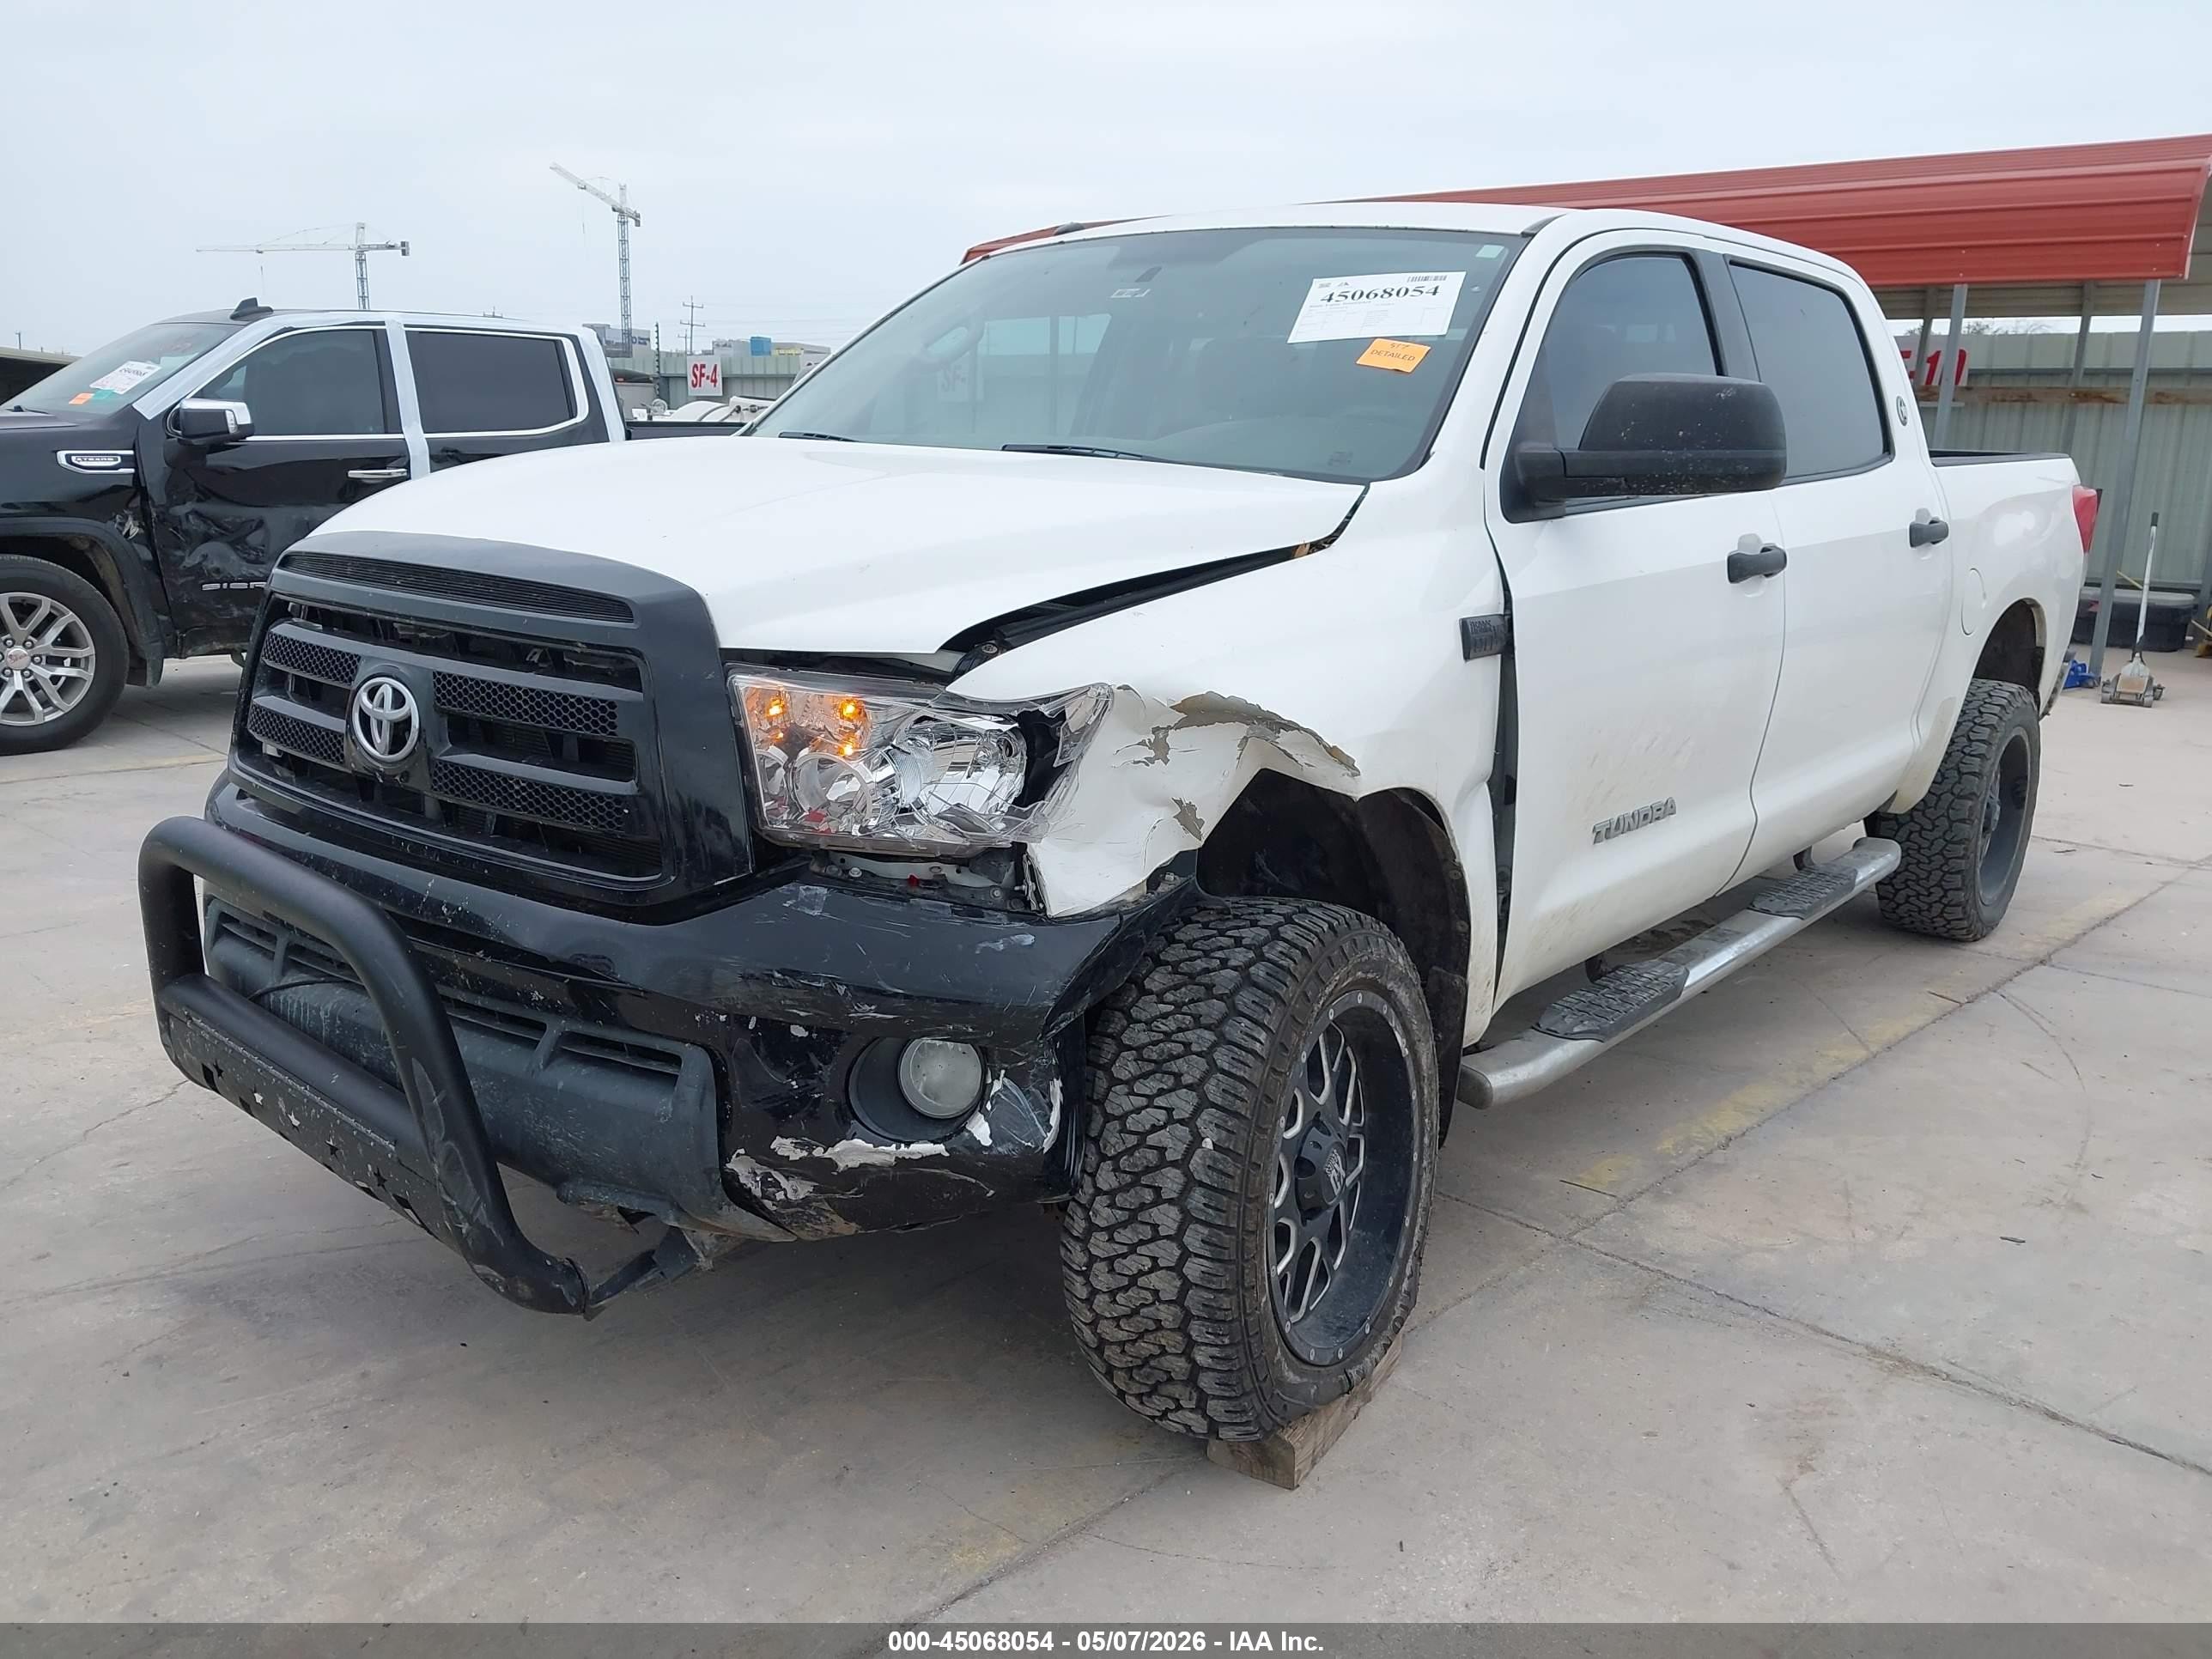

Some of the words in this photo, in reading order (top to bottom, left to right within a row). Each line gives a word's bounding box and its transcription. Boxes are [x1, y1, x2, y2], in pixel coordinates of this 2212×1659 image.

[1320, 285, 1440, 303] 45068054
[1370, 349, 1416, 362] DETAILED
[690, 363, 718, 388] SF-4
[1592, 797, 1676, 845] TUNDRA
